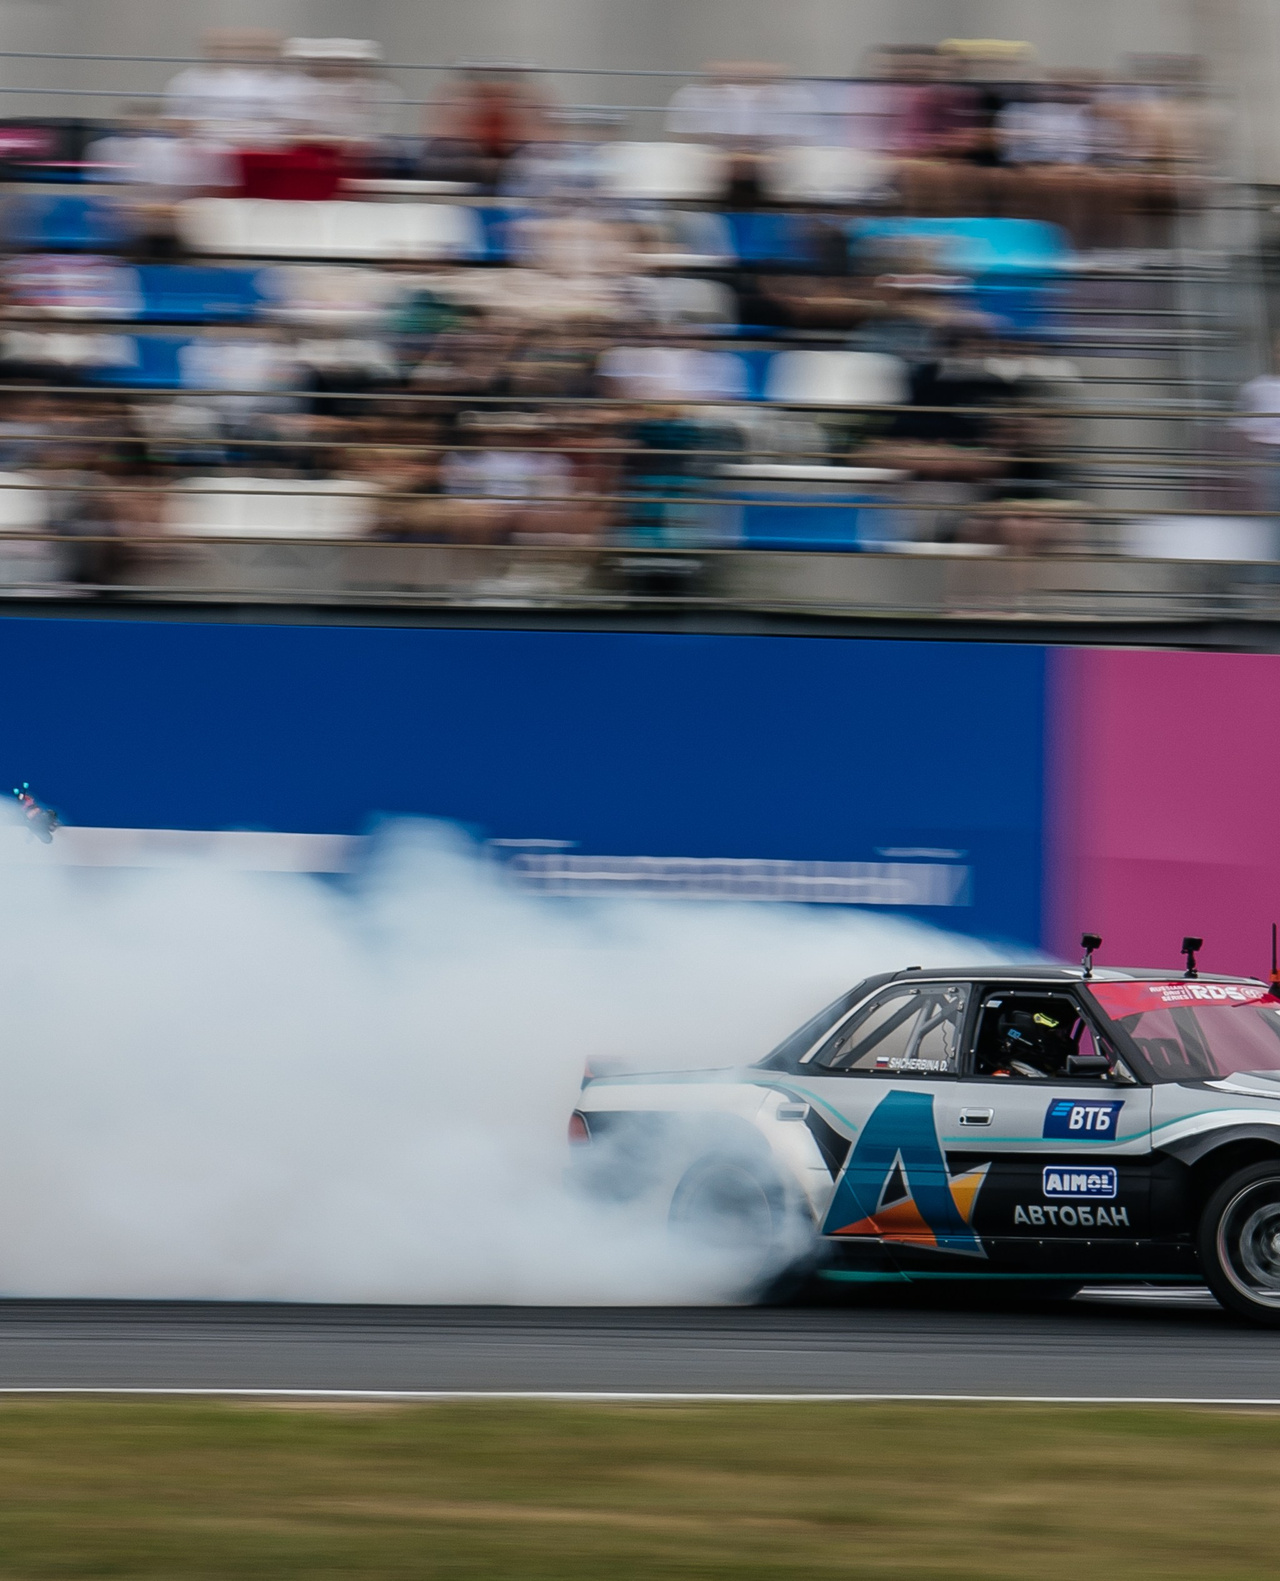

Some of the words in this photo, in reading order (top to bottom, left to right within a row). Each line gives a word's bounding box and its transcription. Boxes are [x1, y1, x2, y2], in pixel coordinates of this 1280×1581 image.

[1187, 985, 1247, 1001] RDS
[940, 1060, 948, 1071] D.
[1068, 1106, 1113, 1131] ВТБ
[1046, 1173, 1113, 1192] AIMOL
[1014, 1204, 1130, 1227] АВТОБАН
